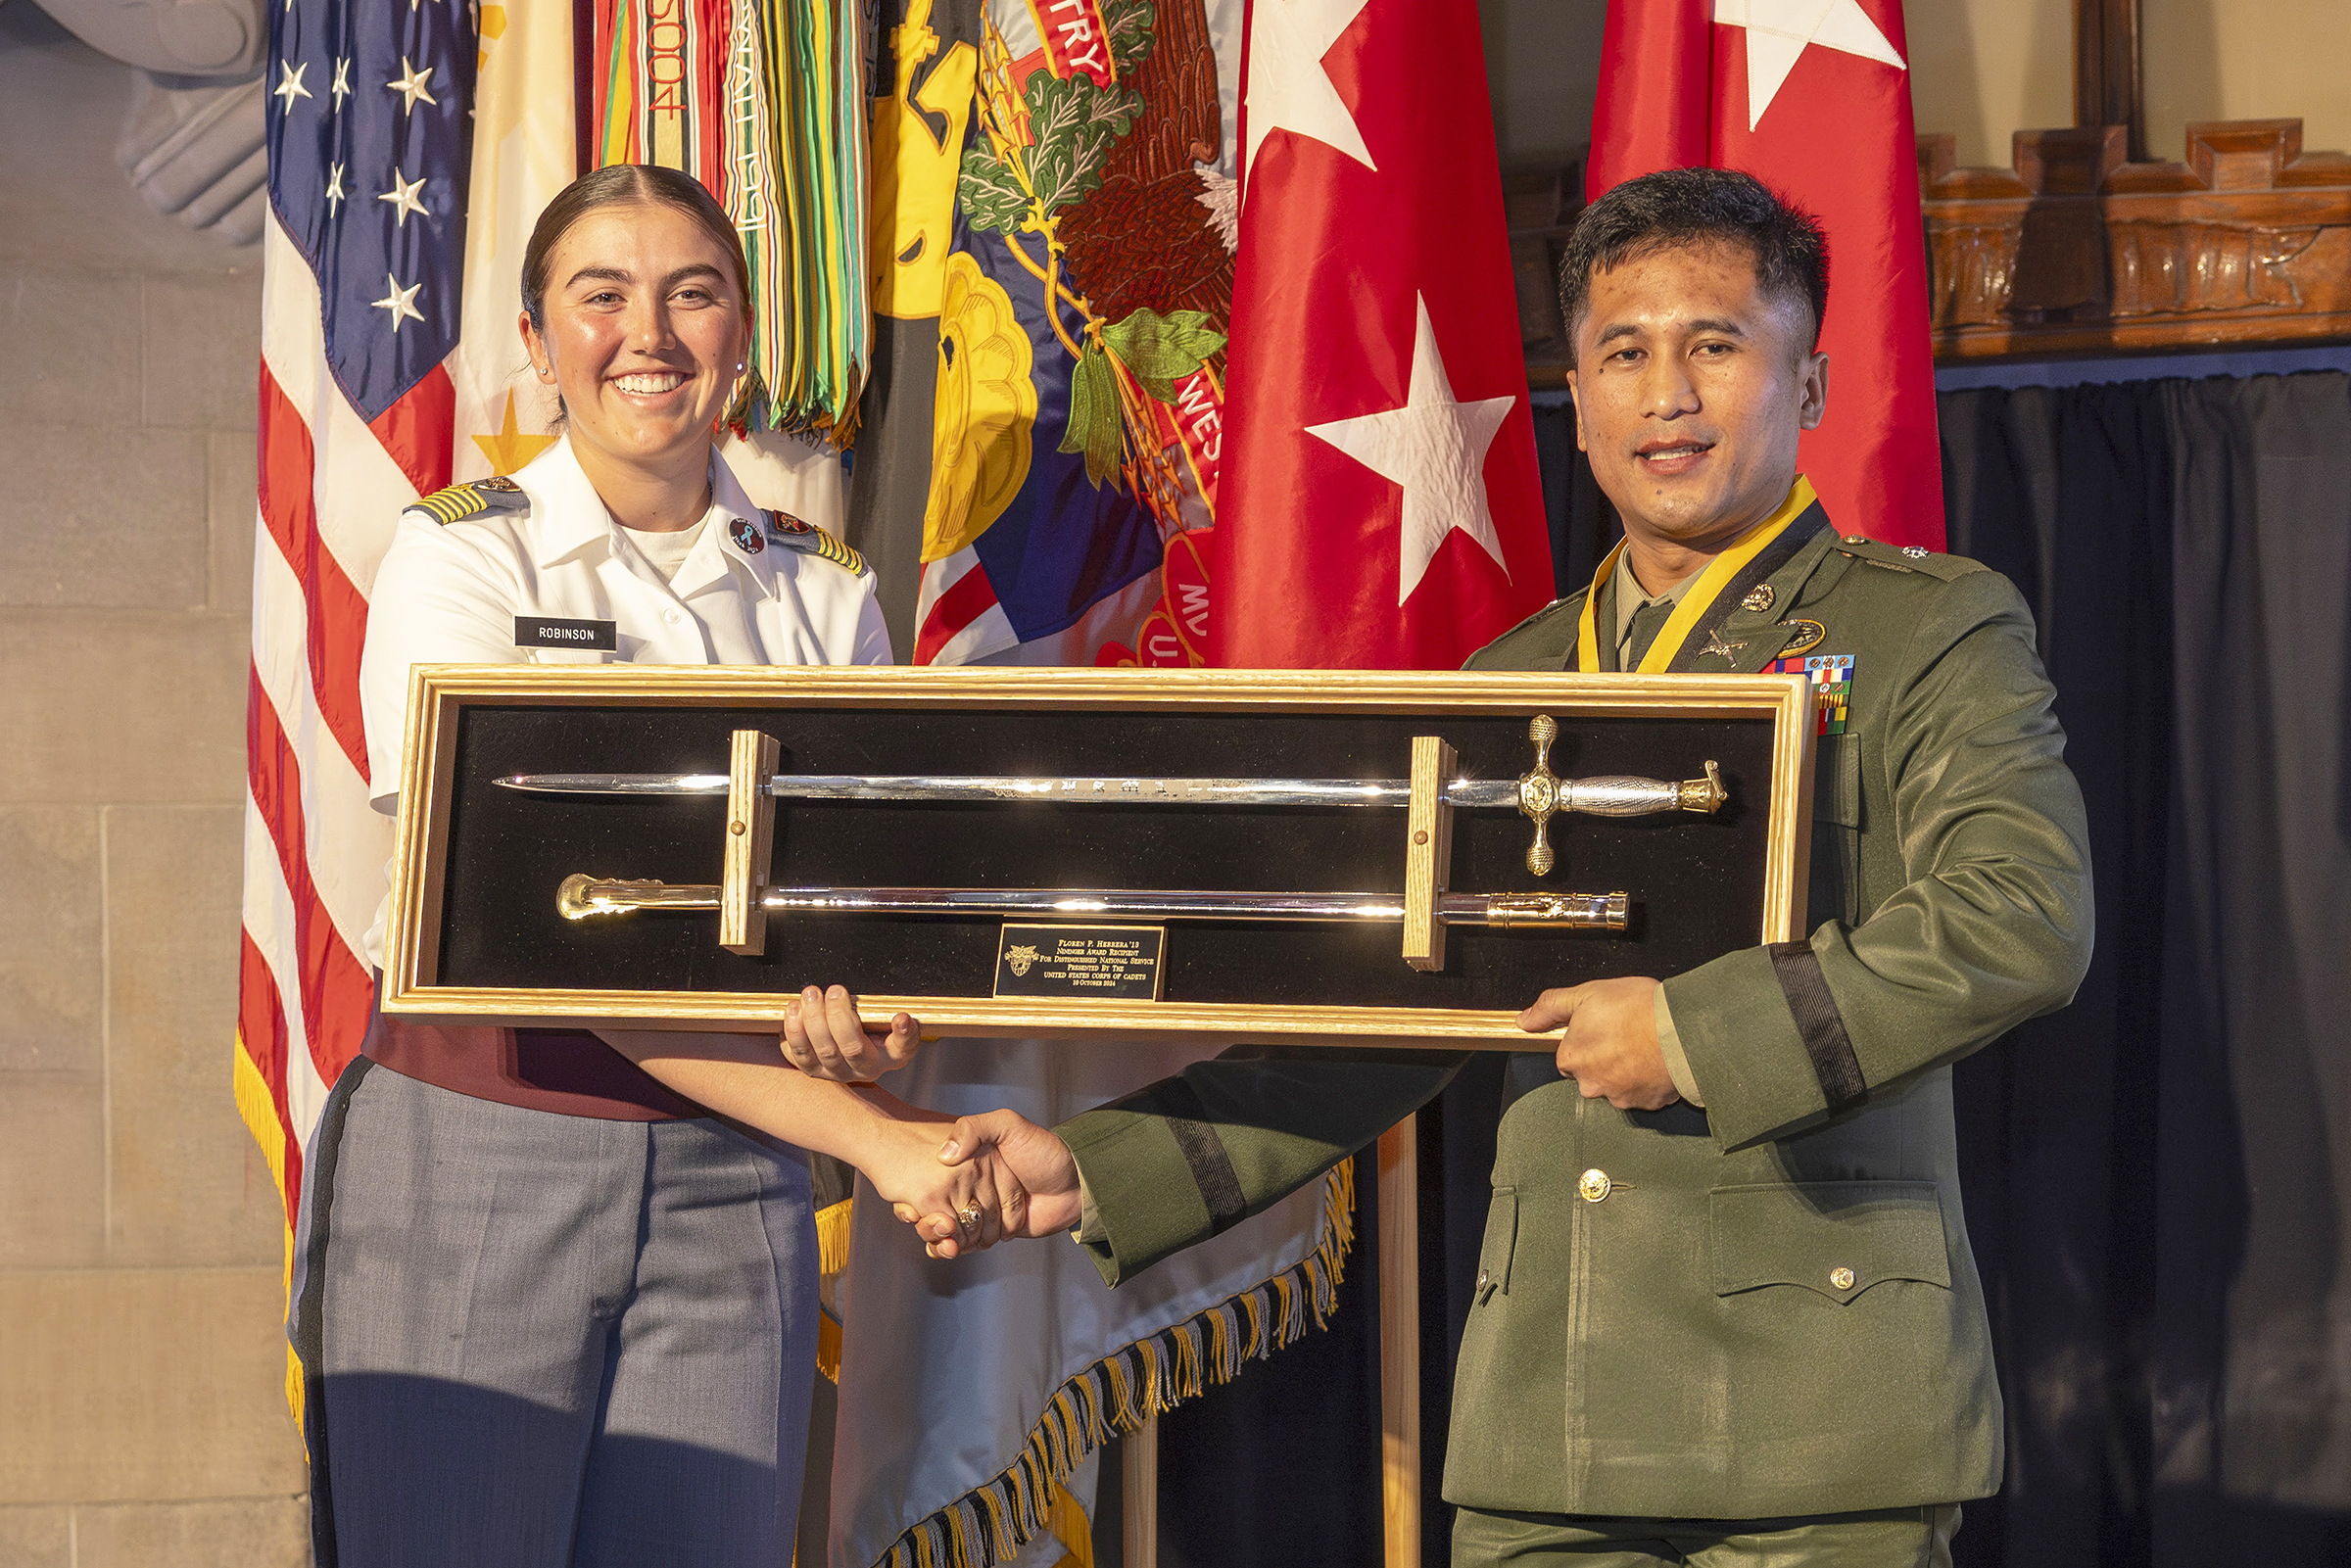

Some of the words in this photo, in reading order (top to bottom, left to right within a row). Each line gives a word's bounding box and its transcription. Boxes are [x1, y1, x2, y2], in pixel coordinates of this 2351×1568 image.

[735, 3, 759, 131] WAIT
[736, 151, 767, 231] 1991
[1177, 375, 1223, 479] WES
[539, 627, 595, 641] ROBINSON
[1054, 955, 1097, 964] DISTINGUISHED
[1099, 956, 1128, 965] NATIONAL
[1109, 948, 1139, 957] RECIPIENT
